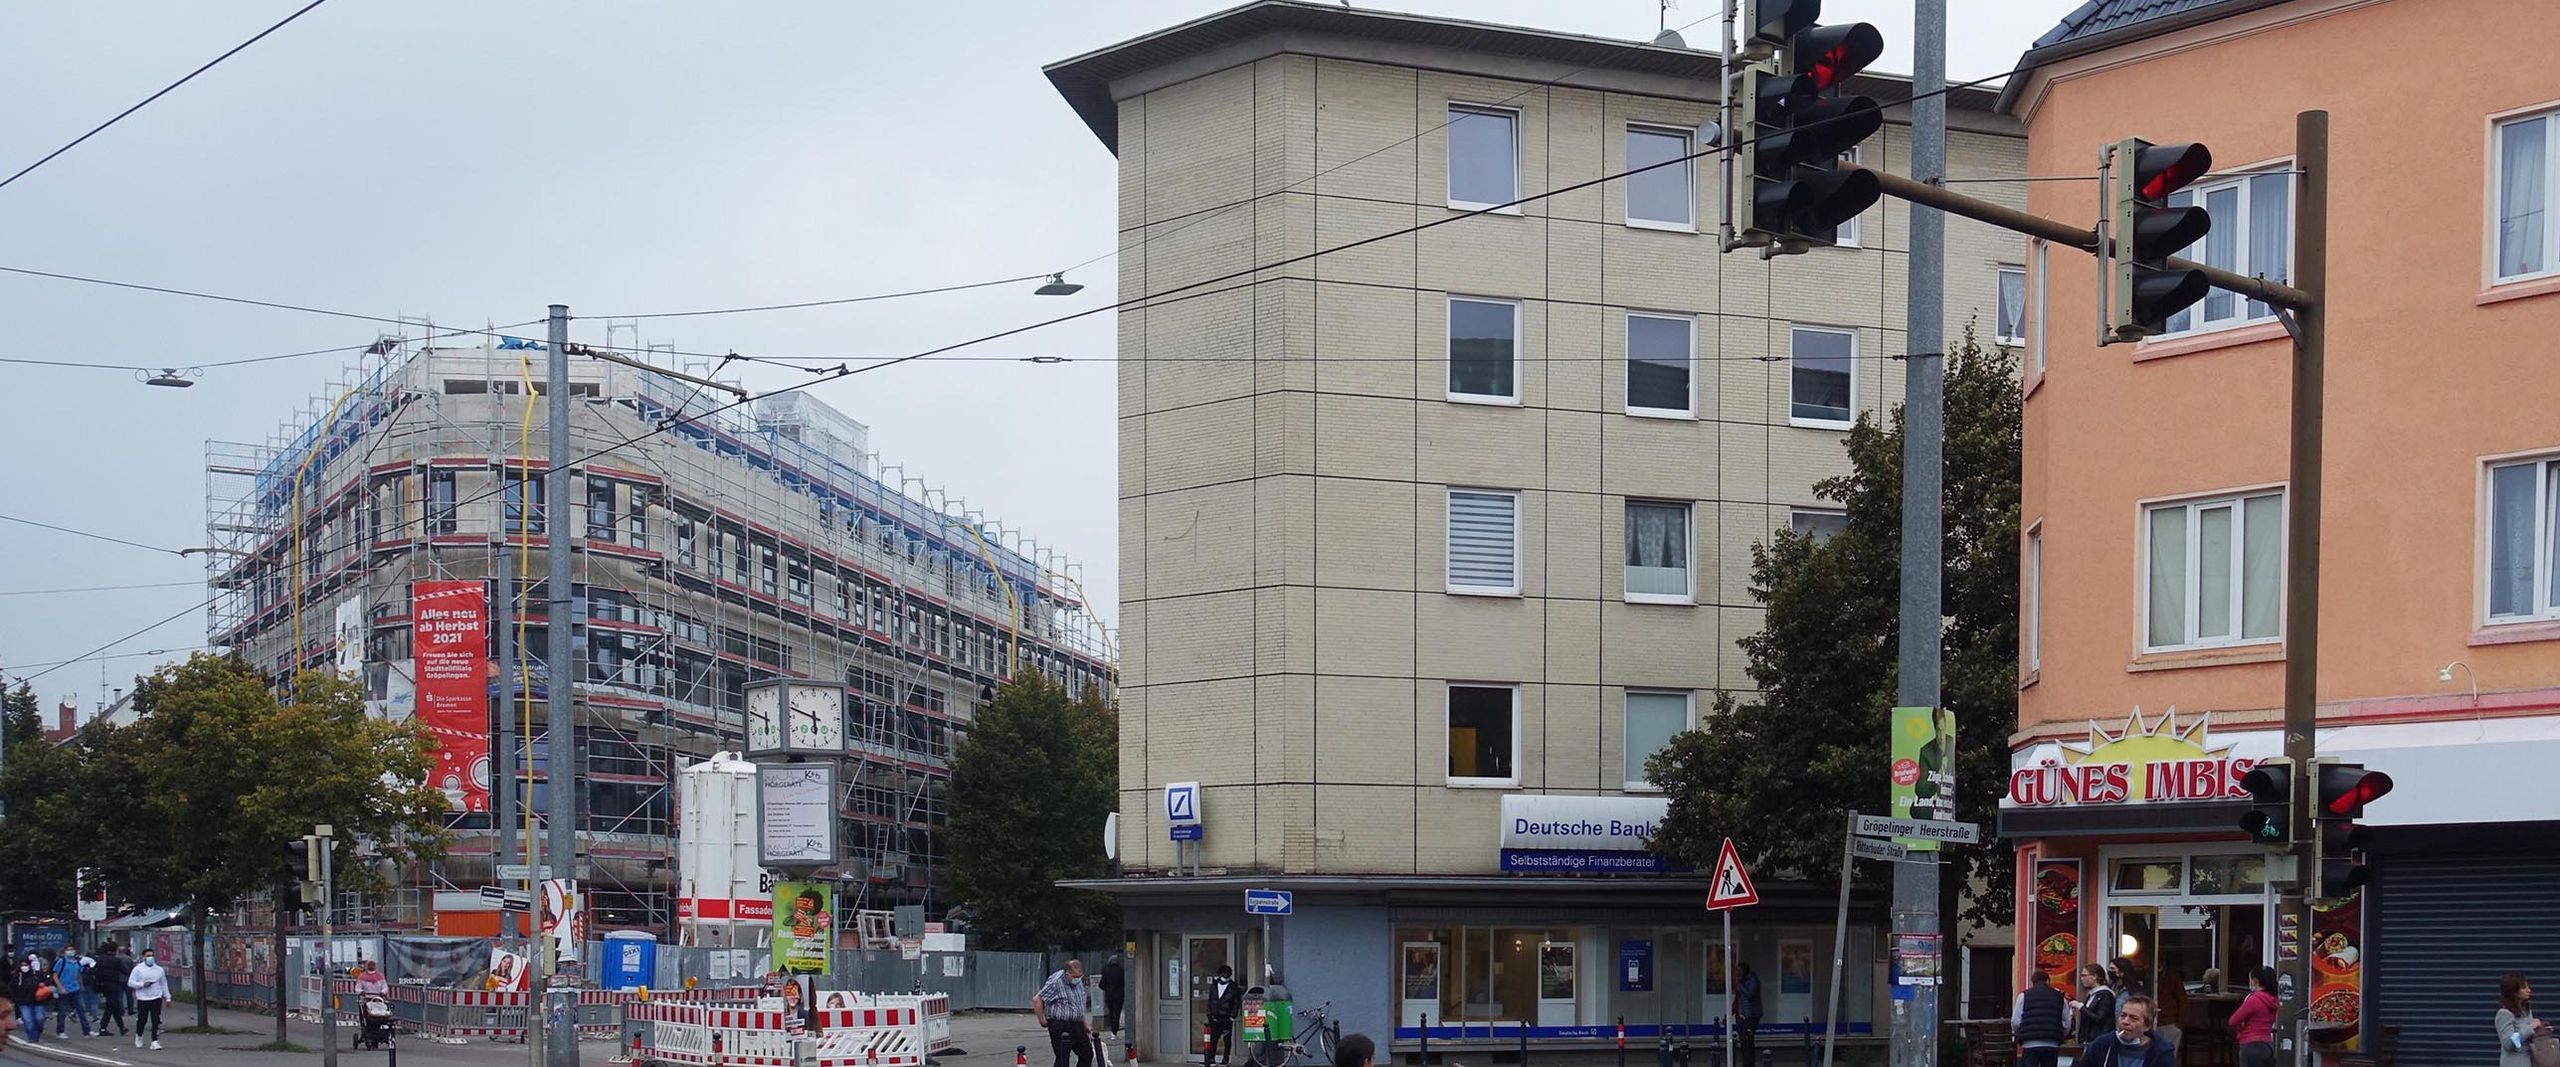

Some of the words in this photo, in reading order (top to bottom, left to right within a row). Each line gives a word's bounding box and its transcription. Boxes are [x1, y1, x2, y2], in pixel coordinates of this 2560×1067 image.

[420, 609, 450, 619] Alles
[452, 610, 477, 619] neu
[419, 622, 433, 632] ab
[435, 621, 479, 632] Herbst
[432, 633, 462, 643] 2021
[2009, 758, 2129, 806] GÜNES
[2144, 757, 2269, 801] IMBIS
[1515, 818, 1603, 836] Deutsche
[1610, 820, 1656, 837] Bank
[1863, 819, 1914, 837] Gröpelinger
[1920, 823, 1970, 839] Heerstraße
[1886, 844, 1904, 858] Straße
[1510, 854, 1586, 868] Selbstständige
[1588, 855, 1656, 867] Finanzberater
[759, 873, 773, 894] Ba
